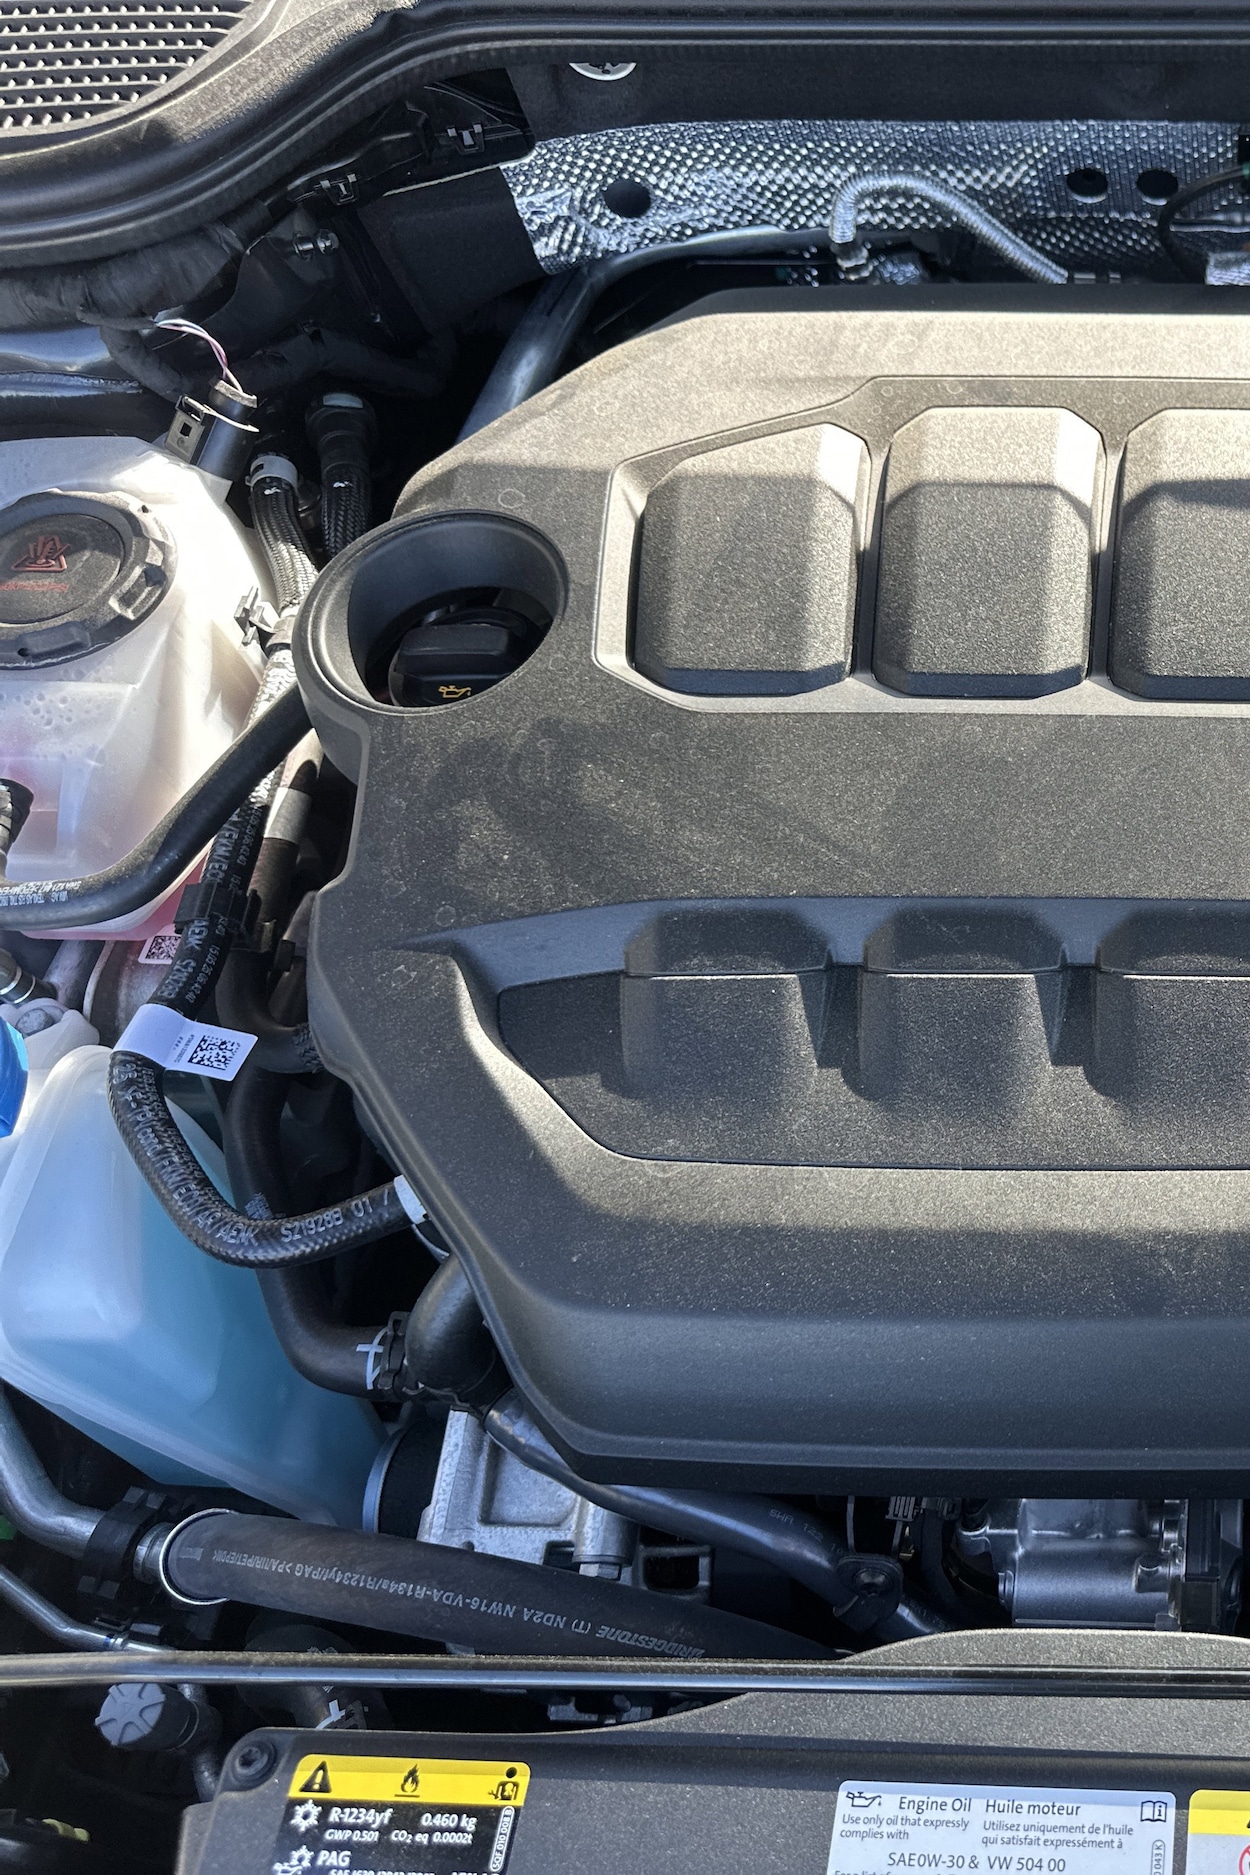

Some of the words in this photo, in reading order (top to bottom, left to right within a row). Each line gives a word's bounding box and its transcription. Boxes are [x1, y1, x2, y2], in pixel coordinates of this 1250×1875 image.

[523, 1607, 567, 1629] ND2A
[572, 1619, 592, 1635] (T)
[596, 1625, 705, 1659] BRIDGESTONE
[899, 1796, 947, 1814] Engine
[951, 1797, 972, 1812] Oil
[985, 1799, 1023, 1814] Huile
[1027, 1803, 1081, 1816] moteur
[328, 1806, 393, 1828] R-1234yf
[421, 1813, 457, 1827] 0.460
[460, 1813, 477, 1831] kg
[842, 1814, 861, 1824] Use
[863, 1814, 885, 1828] only
[886, 1815, 898, 1826] oil
[900, 1816, 921, 1827] that
[923, 1817, 969, 1831] expressly
[840, 1828, 884, 1841] complies
[886, 1829, 909, 1840] with
[983, 1820, 1020, 1832] Utilisez
[1023, 1822, 1086, 1835] uniquement
[1088, 1823, 1100, 1834] de
[1103, 1823, 1134, 1836] l'huile
[325, 1829, 351, 1841] GWP
[353, 1831, 379, 1842] 0.501
[415, 1834, 428, 1845] eq
[432, 1832, 473, 1845] 0.0002t
[981, 1834, 998, 1847] qui
[1000, 1834, 1040, 1846] satisfait
[1043, 1836, 1114, 1850] expressément
[1117, 1837, 1123, 1849] à
[316, 1850, 352, 1867] PAG
[968, 1855, 980, 1869] &
[987, 1855, 1013, 1870] VW
[1016, 1857, 1044, 1871] 504
[1047, 1858, 1066, 1872] 00
[1153, 1852, 1163, 1869] 043
